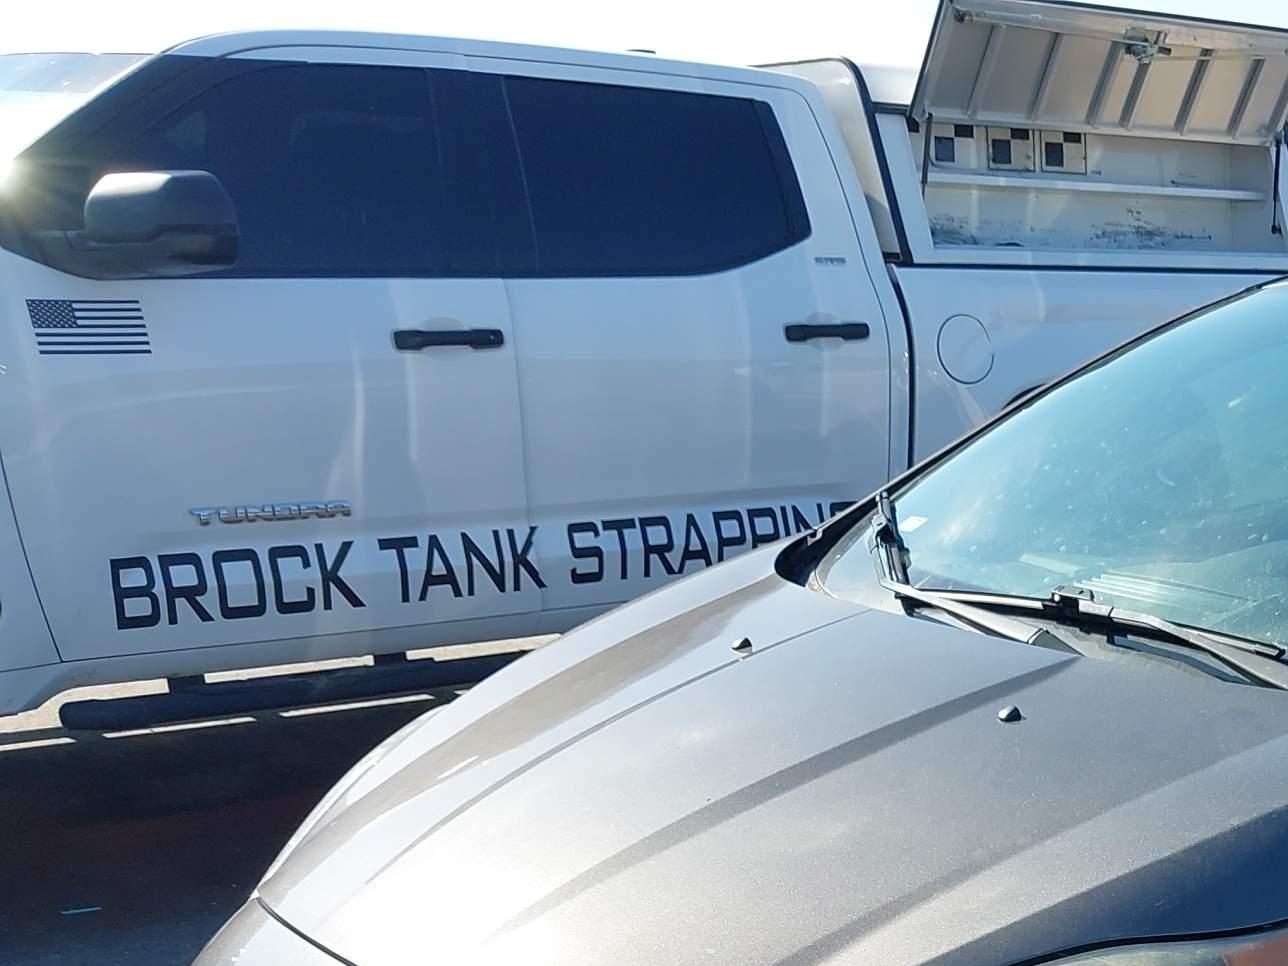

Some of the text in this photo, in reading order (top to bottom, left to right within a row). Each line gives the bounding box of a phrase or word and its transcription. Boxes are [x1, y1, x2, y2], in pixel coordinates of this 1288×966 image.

[190, 500, 352, 526] TUNDRA
[110, 500, 860, 631] BROCK TANK STRAPPIN
